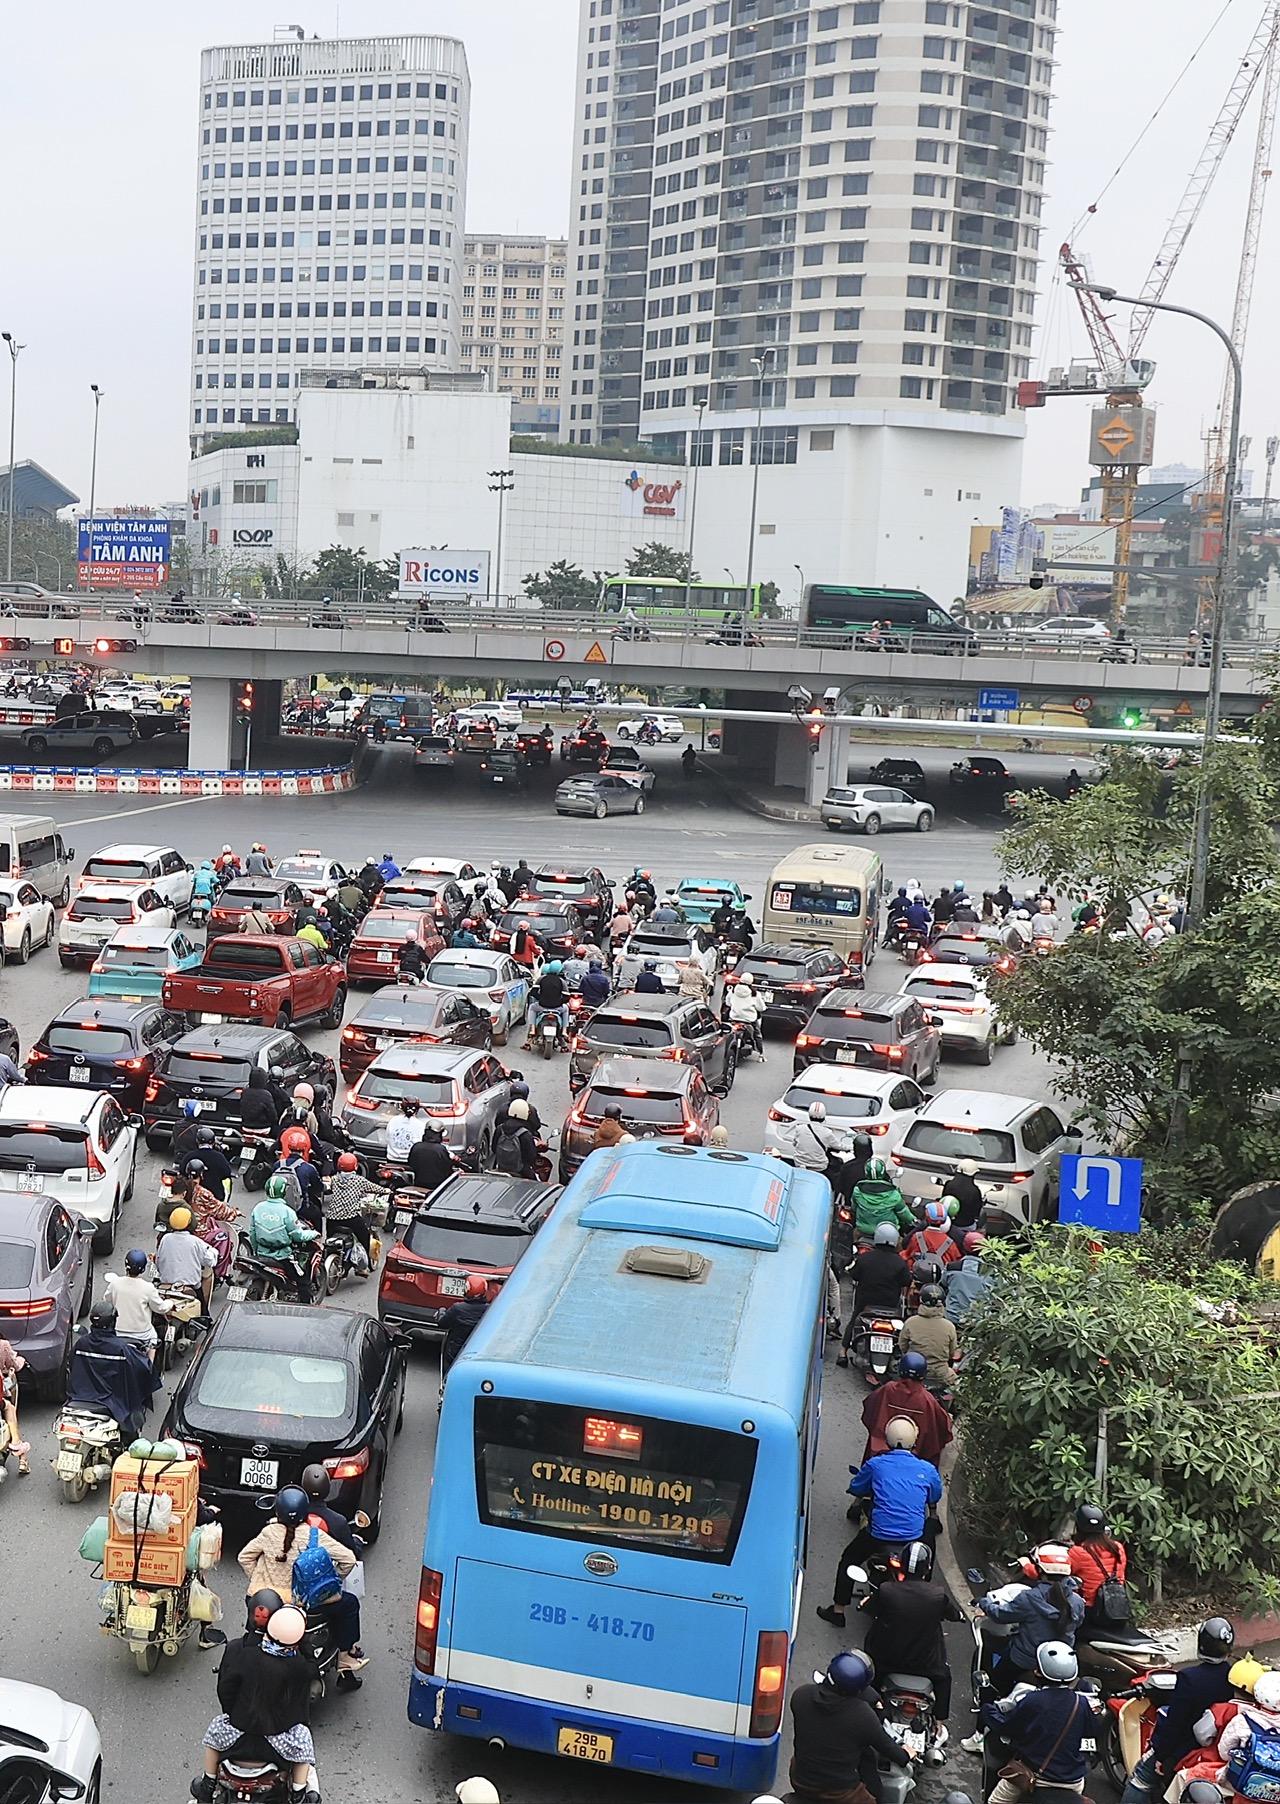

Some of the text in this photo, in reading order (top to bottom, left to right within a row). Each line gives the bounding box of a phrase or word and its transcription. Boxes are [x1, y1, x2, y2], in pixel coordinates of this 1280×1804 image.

[105, 521, 125, 534] VIỆN
[127, 522, 146, 533] TÂM
[148, 523, 167, 533] ANH
[233, 529, 273, 543] LOOP
[92, 542, 164, 562] TÂM ANH
[106, 567, 120, 575] 24/7
[60, 639, 72, 653] 10
[249, 1460, 271, 1472] 30U
[244, 1472, 274, 1485] 0066
[559, 1465, 581, 1485] XE
[585, 1470, 626, 1495] ĐIỆN
[630, 1475, 654, 1496] HÀ
[658, 1480, 693, 1506] NỘI
[531, 1492, 714, 1536] Hotline 1900.1296
[529, 1602, 567, 1626] 29B
[587, 1613, 655, 1642] 418.70
[574, 1732, 598, 1746] 29B
[563, 1743, 606, 1761] 418.70
